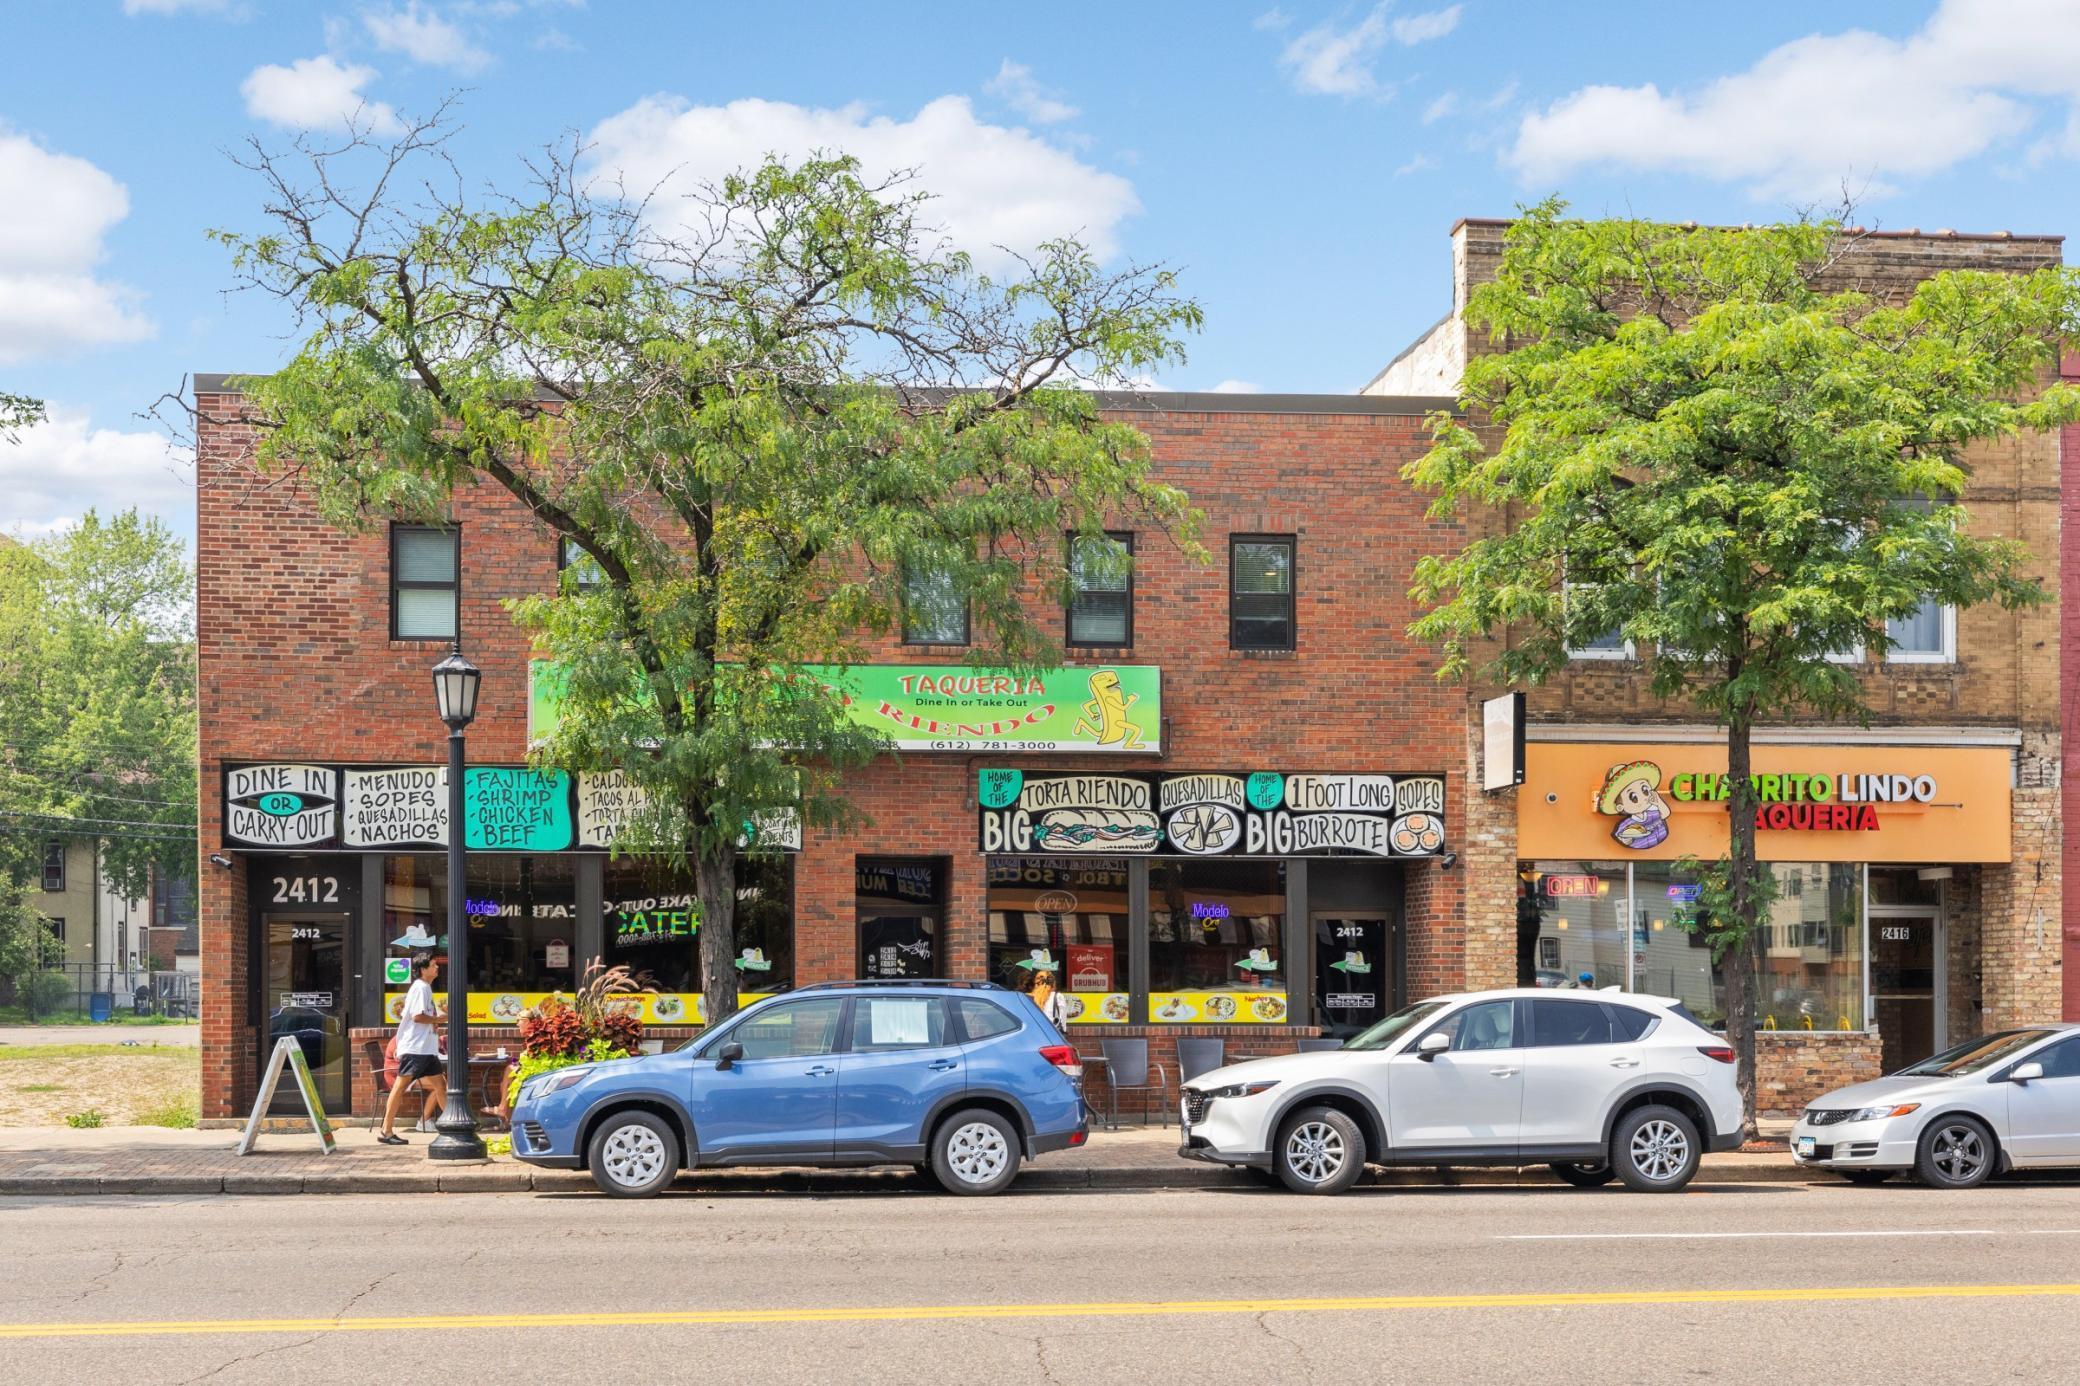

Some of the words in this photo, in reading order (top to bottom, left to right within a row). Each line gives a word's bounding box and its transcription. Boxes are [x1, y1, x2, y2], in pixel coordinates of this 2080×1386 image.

[899, 675, 1046, 696] TAQUERIA
[916, 698, 943, 706] Dine
[946, 699, 958, 707] In
[977, 699, 1004, 707] Take
[1006, 699, 1028, 707] Out
[876, 700, 1056, 736] RIENDO
[931, 740, 970, 750] (612)
[982, 740, 1056, 750] 781-3000
[236, 767, 292, 795] DINE
[304, 770, 327, 794] IN
[359, 771, 435, 791] MENUDO
[477, 771, 558, 790] FAJITAS
[592, 773, 628, 789] CALDO
[988, 771, 1013, 782] HOME
[1254, 773, 1277, 784] HOME
[993, 782, 1003, 791] OF
[1024, 781, 1071, 807] TORTA
[1077, 779, 1147, 809] RIENDO
[1163, 777, 1242, 807] QUESADILLAS
[1260, 785, 1270, 794] OF
[1292, 778, 1302, 808] 1
[1305, 777, 1346, 808] FOOT
[1350, 777, 1391, 808] LONG
[1671, 773, 1833, 802] CHARITO
[1840, 774, 1937, 802] LINDO
[271, 797, 293, 810] OR
[360, 790, 435, 807] SOPES
[478, 789, 551, 806] SHRIMP
[590, 790, 623, 808] TACOS
[627, 790, 641, 806] AL
[988, 791, 1009, 805] THE
[1255, 794, 1274, 806] THE
[1399, 780, 1440, 812] SOPES
[358, 808, 448, 826] QUESADILLAS
[479, 806, 553, 826] CHICKEN
[591, 807, 626, 823] TORTA
[1753, 804, 1879, 831] AQUERIA
[233, 809, 332, 843] CARRY-OUT
[361, 823, 439, 842] NACHOS
[984, 811, 1032, 851] BIG
[1247, 811, 1295, 853] BIG
[1296, 816, 1385, 850] BURROTE
[484, 825, 537, 846] BEEF
[272, 877, 339, 903] 2412
[1549, 877, 1597, 894] OPEN
[1037, 897, 1073, 910] OPEN
[1192, 903, 1229, 918] Modelo
[291, 928, 320, 938] 2412
[1337, 927, 1364, 937] 2412
[1882, 927, 1909, 939] 2416
[1077, 953, 1105, 962] deliver
[1074, 978, 1107, 987] GRUBHUB
